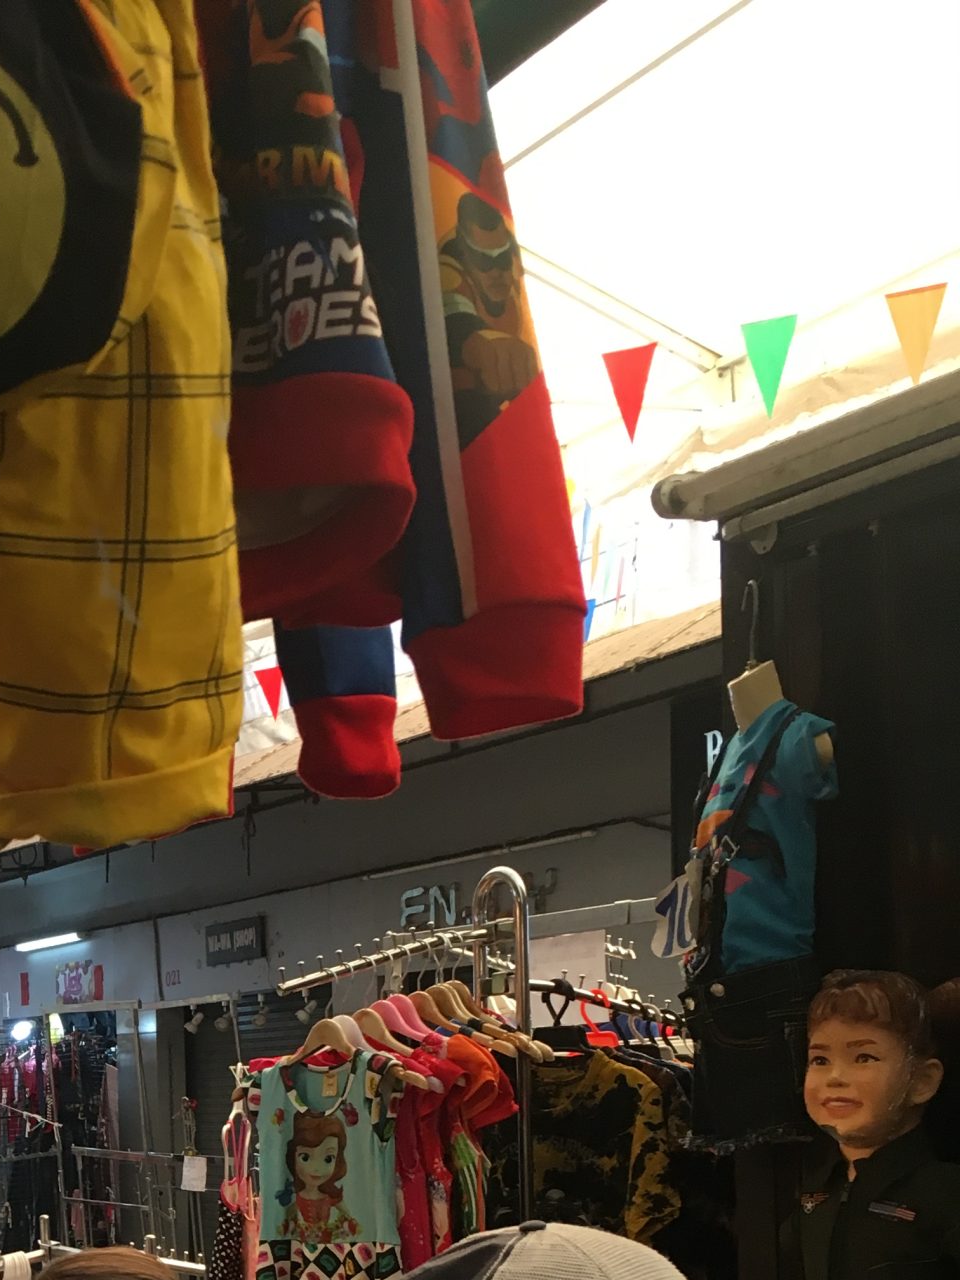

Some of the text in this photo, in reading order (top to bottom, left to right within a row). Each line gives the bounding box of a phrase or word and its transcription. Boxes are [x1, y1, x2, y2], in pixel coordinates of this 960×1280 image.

[242, 237, 365, 318] TEAM
[233, 290, 384, 373] EROES
[165, 970, 182, 987] 021
